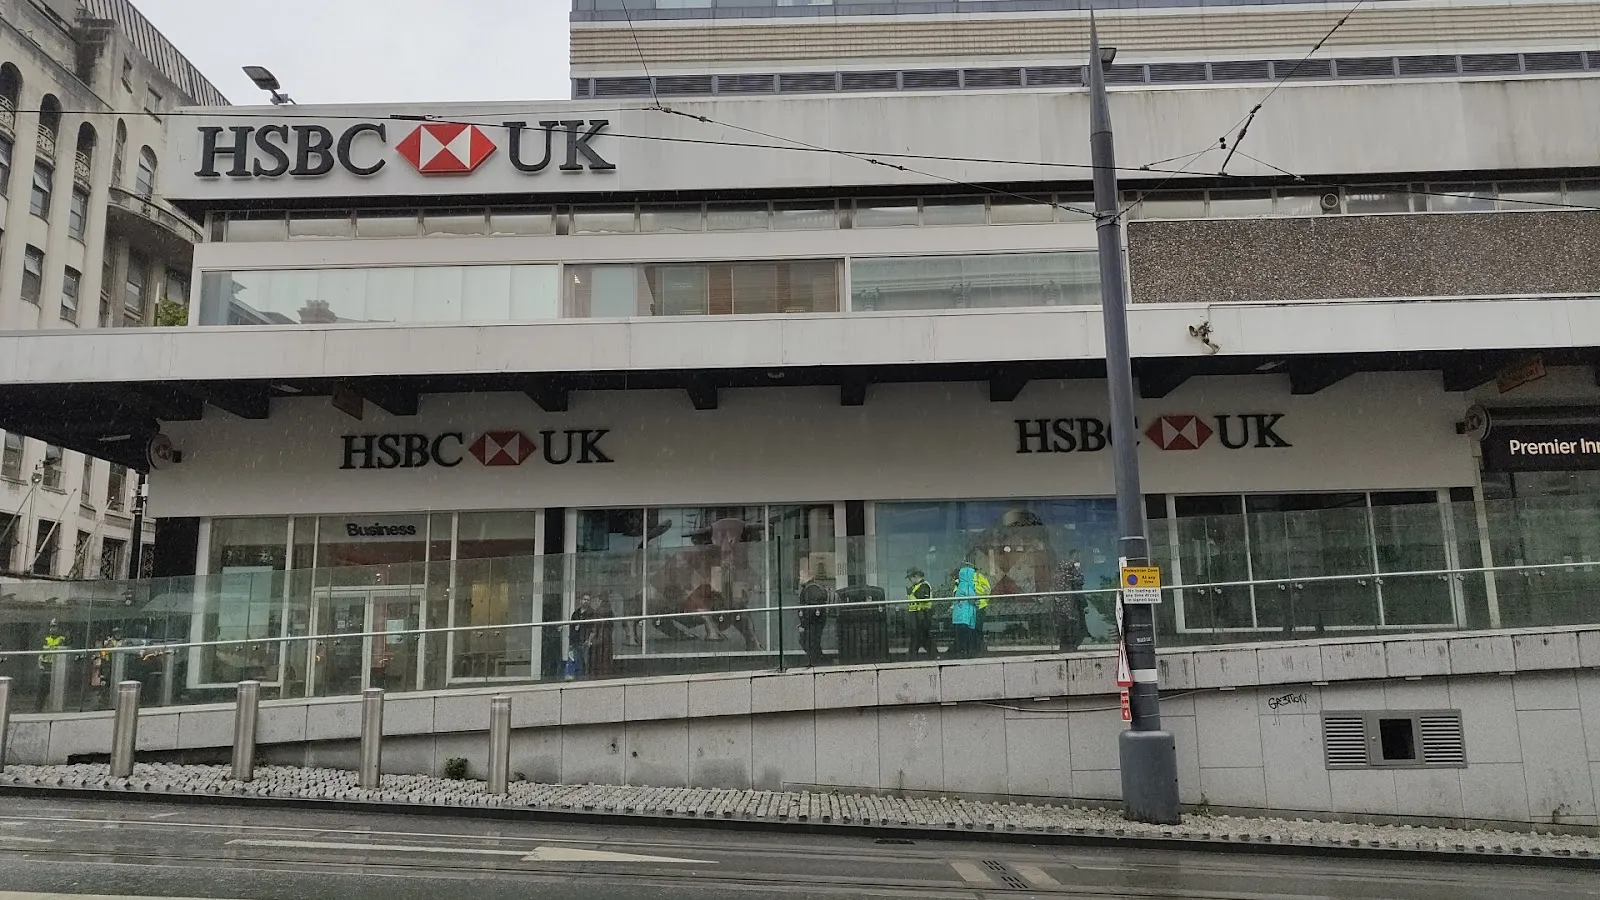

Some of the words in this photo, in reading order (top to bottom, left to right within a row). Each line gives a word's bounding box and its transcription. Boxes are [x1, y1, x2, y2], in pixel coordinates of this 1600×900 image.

[194, 122, 387, 178] HSBC
[503, 119, 617, 172] UK
[1214, 413, 1293, 449] UK
[1509, 439, 1577, 455] Premier
[339, 432, 464, 470] HSBC
[539, 429, 615, 465] UK
[346, 522, 416, 536] Business
